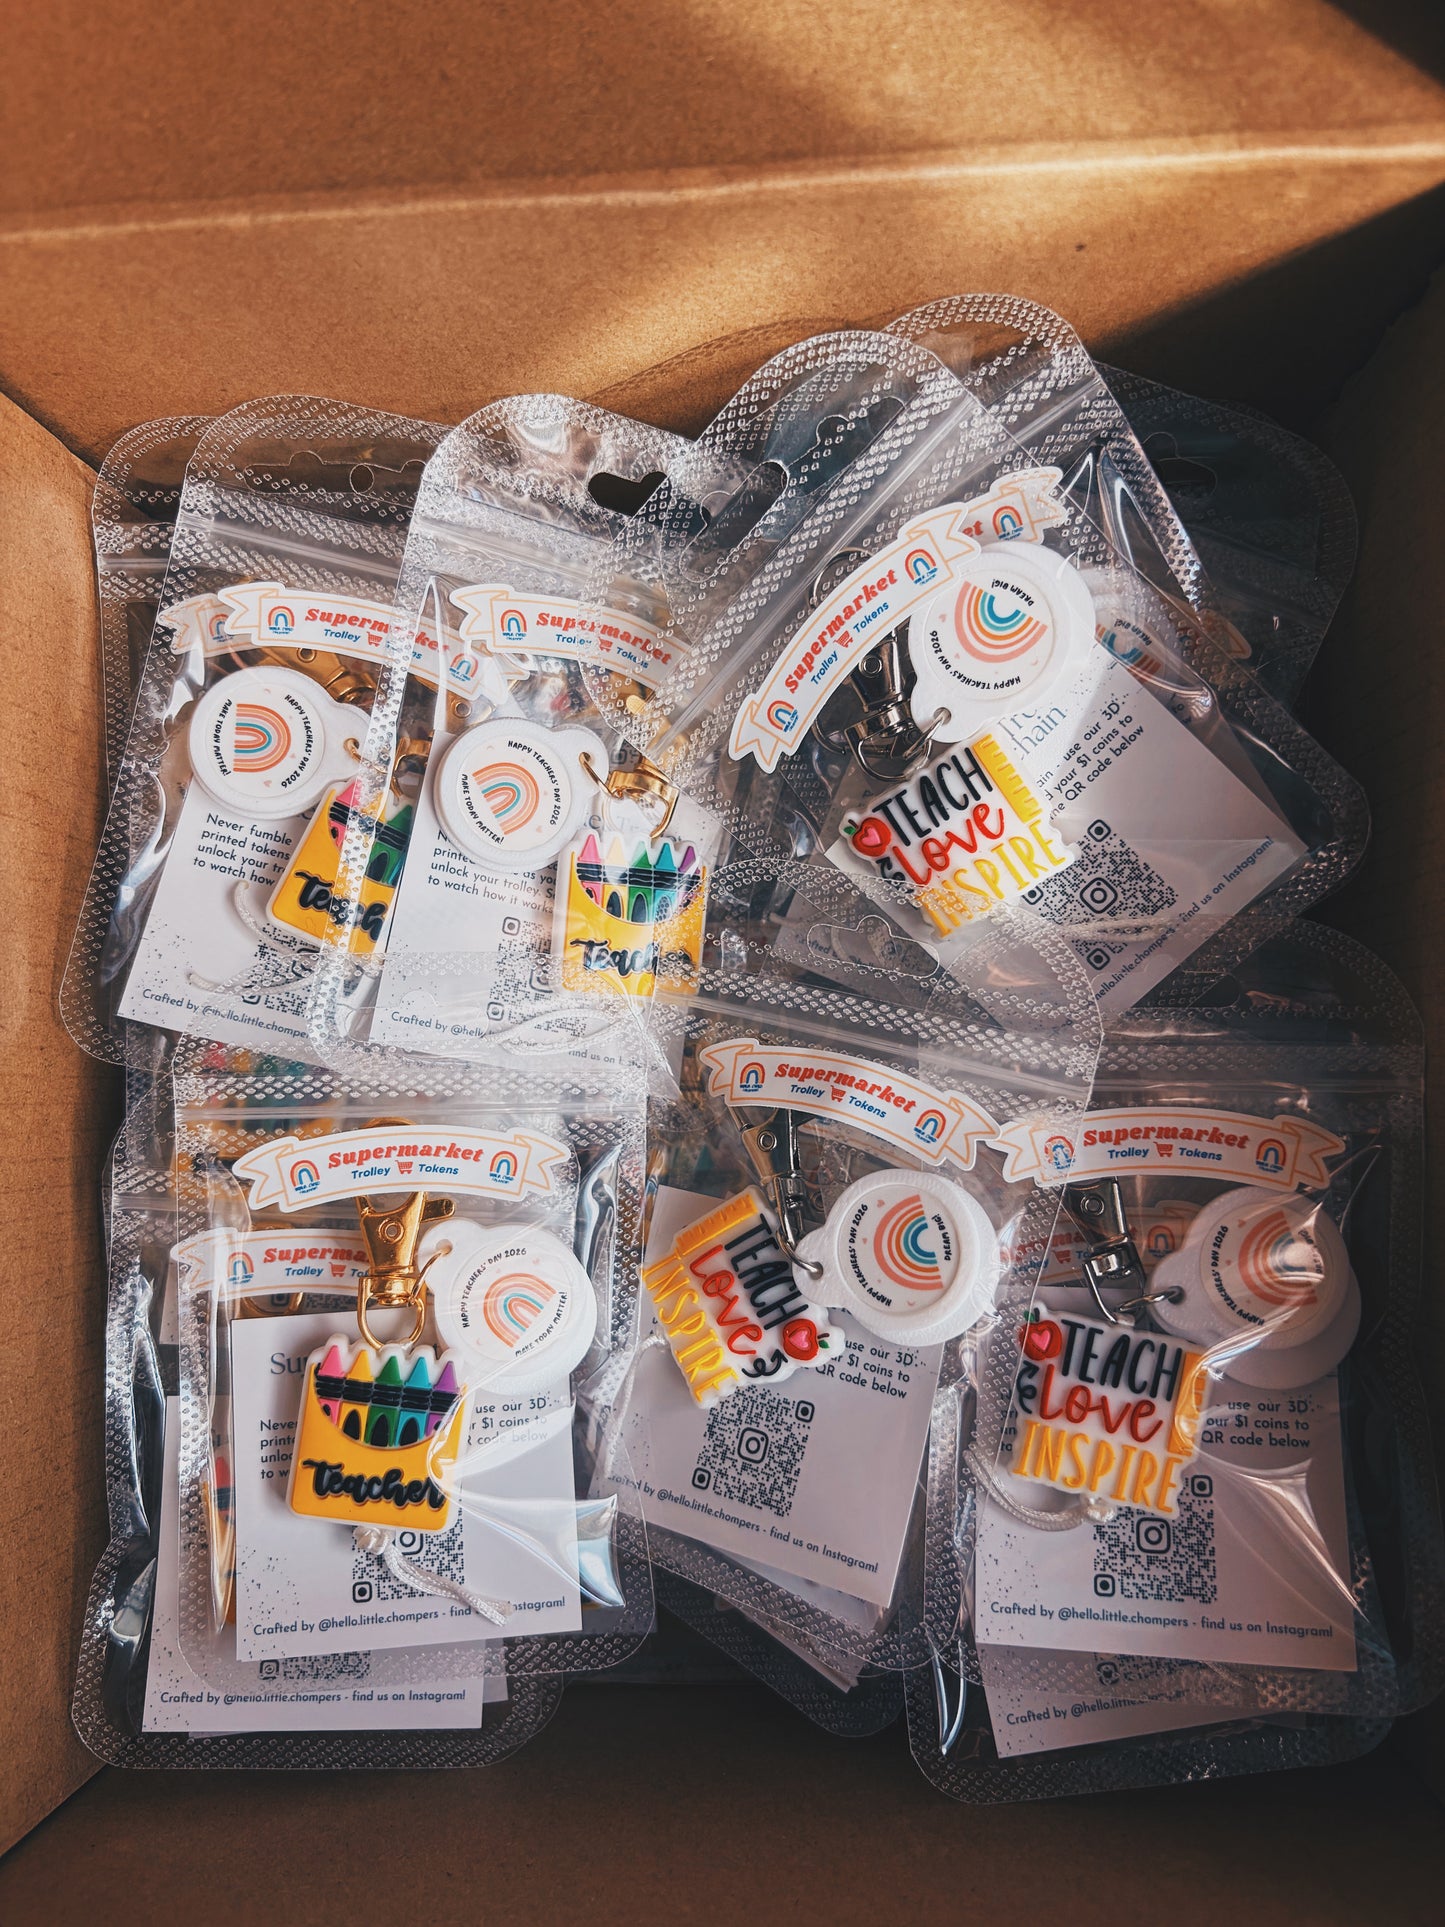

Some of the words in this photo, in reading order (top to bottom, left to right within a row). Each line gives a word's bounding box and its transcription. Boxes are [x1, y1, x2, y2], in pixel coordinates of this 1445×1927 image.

[992, 578, 1008, 590] BIG!
[1010, 585, 1034, 606] DREAM
[305, 608, 449, 651] Supermke
[324, 629, 361, 643] Trolley
[785, 568, 898, 694] Supermarket
[811, 650, 838, 685] Trolley
[853, 600, 889, 634] Tokens
[930, 630, 942, 654] 2026
[938, 656, 951, 670] DAY
[950, 670, 990, 690] TEACHERS'
[994, 676, 1021, 690] HAPPY
[219, 699, 232, 718] MAKE
[284, 694, 305, 715] HAPPY
[214, 720, 223, 744] TODAY
[302, 716, 314, 756] TEACHERS'
[1064, 742, 1082, 762] use
[1084, 722, 1102, 741] our
[1102, 702, 1120, 720] 3D
[214, 746, 231, 776] MATTER!
[298, 756, 309, 772] DAY
[1054, 768, 1078, 794] your
[1076, 754, 1092, 768] $1
[1092, 728, 1120, 755] coins
[1118, 714, 1133, 728] to
[1065, 781, 1086, 801] QR
[1086, 758, 1112, 783] code
[1110, 725, 1144, 757] below
[282, 770, 300, 788] 2026
[462, 774, 470, 794] MAKE
[508, 740, 532, 754] HAPPY
[533, 752, 558, 786] TEACHERS'
[550, 804, 560, 825] 2026
[465, 797, 479, 820] TODAY
[872, 746, 993, 847] TEACH
[207, 812, 244, 832] Never
[250, 824, 292, 846] fumble
[476, 820, 504, 844] MATTER!
[198, 844, 236, 861] unlock
[241, 853, 268, 869] your
[201, 829, 248, 848] printed
[252, 841, 290, 860] tokens
[194, 857, 206, 868] to
[210, 862, 246, 878] watch
[250, 871, 276, 886] how
[431, 862, 468, 878] unlock
[474, 872, 499, 884] your
[504, 878, 541, 896] trolley.
[915, 819, 1067, 938] INSPIRE
[1201, 893, 1213, 905] us
[1212, 882, 1226, 895] on
[1224, 836, 1274, 882] Instagram!
[428, 875, 440, 885] to
[444, 881, 478, 895] watch
[483, 886, 506, 902] how
[510, 895, 518, 904] it
[522, 900, 552, 914] works
[142, 989, 184, 1006] Crafted
[186, 1000, 198, 1012] by
[391, 1011, 432, 1028] Crafted
[435, 1020, 448, 1032] by
[590, 1053, 600, 1061] us
[604, 1056, 616, 1064] on
[774, 1063, 917, 1114] Supermarket
[790, 1084, 826, 1098] Trolley
[849, 1095, 888, 1118] Tokens
[1084, 1125, 1250, 1150] Supermarket
[328, 1142, 484, 1169] Supermarket
[1108, 1148, 1149, 1160] Trolley
[1179, 1147, 1222, 1161] Tokens
[352, 1166, 391, 1180] Trolley
[418, 1164, 459, 1175] Tokens
[855, 1204, 868, 1225] 2026
[932, 1214, 946, 1230] BIG!
[849, 1226, 857, 1244] DAY
[943, 1232, 952, 1261] DREAM
[1213, 1225, 1228, 1248] 2026
[264, 1247, 370, 1264] Superma
[488, 1252, 502, 1264] DAY
[504, 1248, 526, 1258] 2026
[1212, 1250, 1220, 1267] DAY
[285, 1266, 324, 1278] Trolley
[724, 1212, 809, 1330] TEACH
[850, 1245, 872, 1289] TEACHERS'
[462, 1262, 486, 1300] TEACHERS'
[1212, 1269, 1238, 1311] TEACHERS'
[868, 1286, 892, 1307] HAPPY
[460, 1301, 470, 1328] HAPPY
[515, 1342, 534, 1357] MAKE
[535, 1324, 554, 1344] TODAY
[554, 1291, 568, 1324] MATTER!
[642, 1247, 739, 1402] INSPIRE
[1237, 1310, 1265, 1326] HAPPY
[845, 1340, 865, 1352] use
[870, 1347, 890, 1359] our
[896, 1352, 914, 1366] 3D
[1061, 1319, 1182, 1401] TEACH
[846, 1354, 859, 1367] $1
[864, 1362, 893, 1378] coins
[898, 1370, 910, 1382] to
[816, 1364, 835, 1378] QR
[840, 1372, 868, 1387] code
[872, 1377, 907, 1399] below
[476, 1404, 496, 1414] use
[502, 1402, 522, 1412] our
[529, 1398, 546, 1410] 3D
[1228, 1401, 1250, 1410] use
[1258, 1402, 1281, 1412] our
[1288, 1400, 1308, 1413] 3D
[482, 1417, 494, 1430] $1
[500, 1418, 530, 1428] coins
[1235, 1414, 1248, 1428] $1
[1254, 1418, 1290, 1430] coins
[1294, 1420, 1309, 1430] to
[512, 1428, 548, 1442] below
[1202, 1430, 1224, 1444] QR
[1230, 1432, 1262, 1446] code
[1269, 1432, 1310, 1448] below
[261, 1468, 274, 1479] to
[1013, 1420, 1184, 1514] INSPIRE
[302, 1459, 447, 1509] Teacher
[644, 1482, 655, 1496] by
[657, 1488, 760, 1533] @hello.little.chompers
[770, 1526, 790, 1543] find
[792, 1536, 804, 1547] us
[806, 1540, 819, 1552] on
[822, 1544, 879, 1574] Instagram!
[253, 1618, 298, 1636] Crafted
[302, 1620, 316, 1634] by
[318, 1610, 438, 1632] @hello.little.chompers
[450, 1606, 472, 1617] find
[512, 1596, 566, 1612] nstagram!
[990, 1602, 1036, 1617] Crafted
[1040, 1604, 1054, 1620] by
[1058, 1606, 1188, 1628] @hello.little.chompers
[1200, 1617, 1226, 1630] find
[1230, 1622, 1242, 1632] us
[1246, 1624, 1262, 1632] on
[1266, 1621, 1334, 1638] Instagram!
[160, 1691, 202, 1703] Crafted
[206, 1692, 220, 1704] by
[352, 1690, 374, 1701] find
[378, 1693, 389, 1701] us
[392, 1693, 405, 1701] on
[408, 1690, 466, 1704] Instagram!
[1006, 1708, 1050, 1724] Crafted
[1053, 1706, 1068, 1719] by
